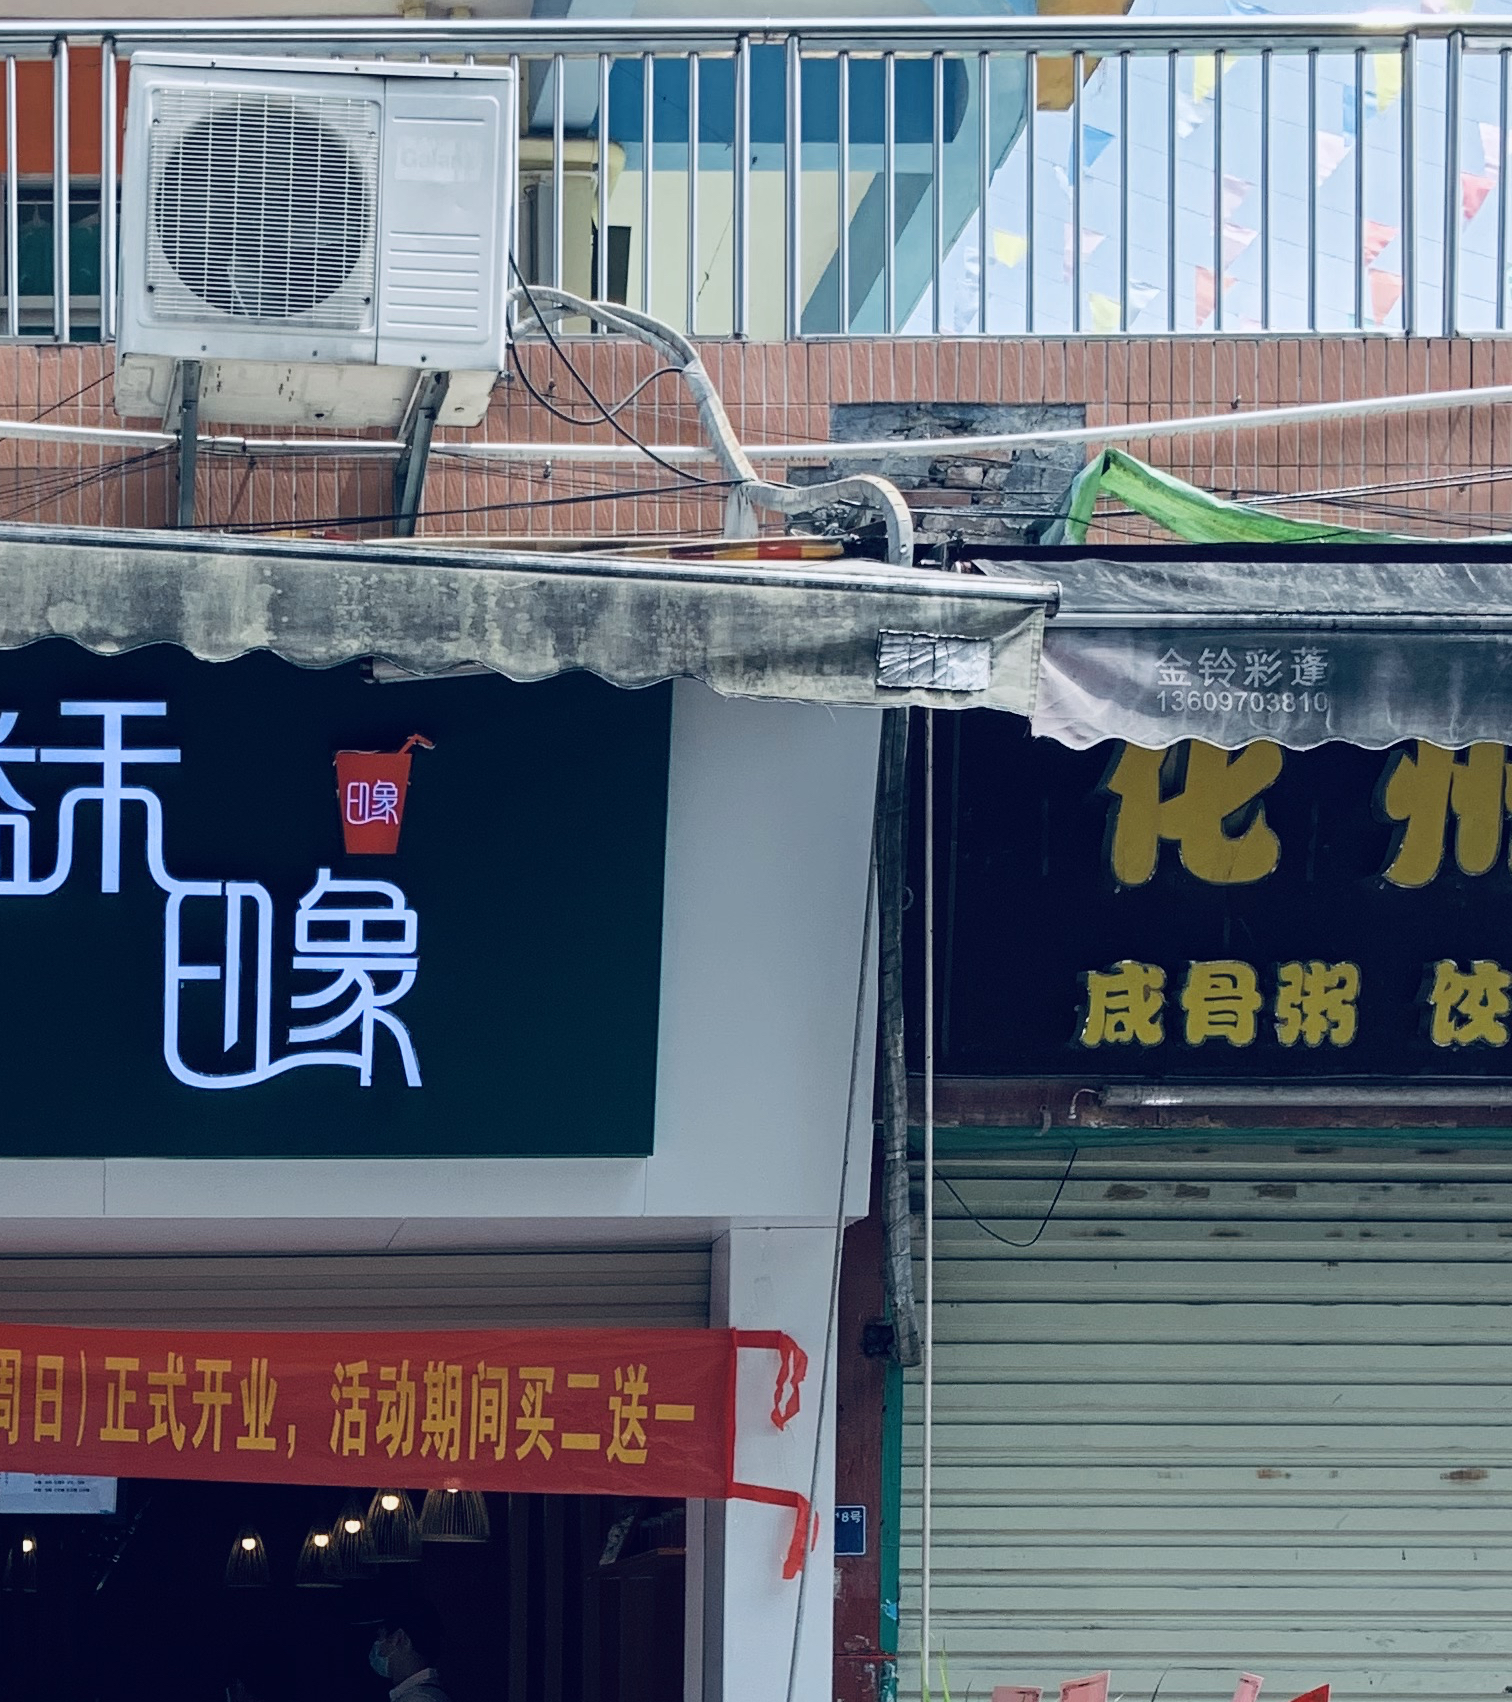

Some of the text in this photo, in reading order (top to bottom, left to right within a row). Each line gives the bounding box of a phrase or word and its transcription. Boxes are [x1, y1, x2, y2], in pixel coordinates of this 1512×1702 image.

[1154, 647, 1328, 688] 金铃彩蓬
[1156, 691, 1328, 712] 13609703810
[346, 779, 399, 825] 印象
[164, 868, 422, 1089] 印象
[1079, 959, 1361, 1048] 咸骨粥
